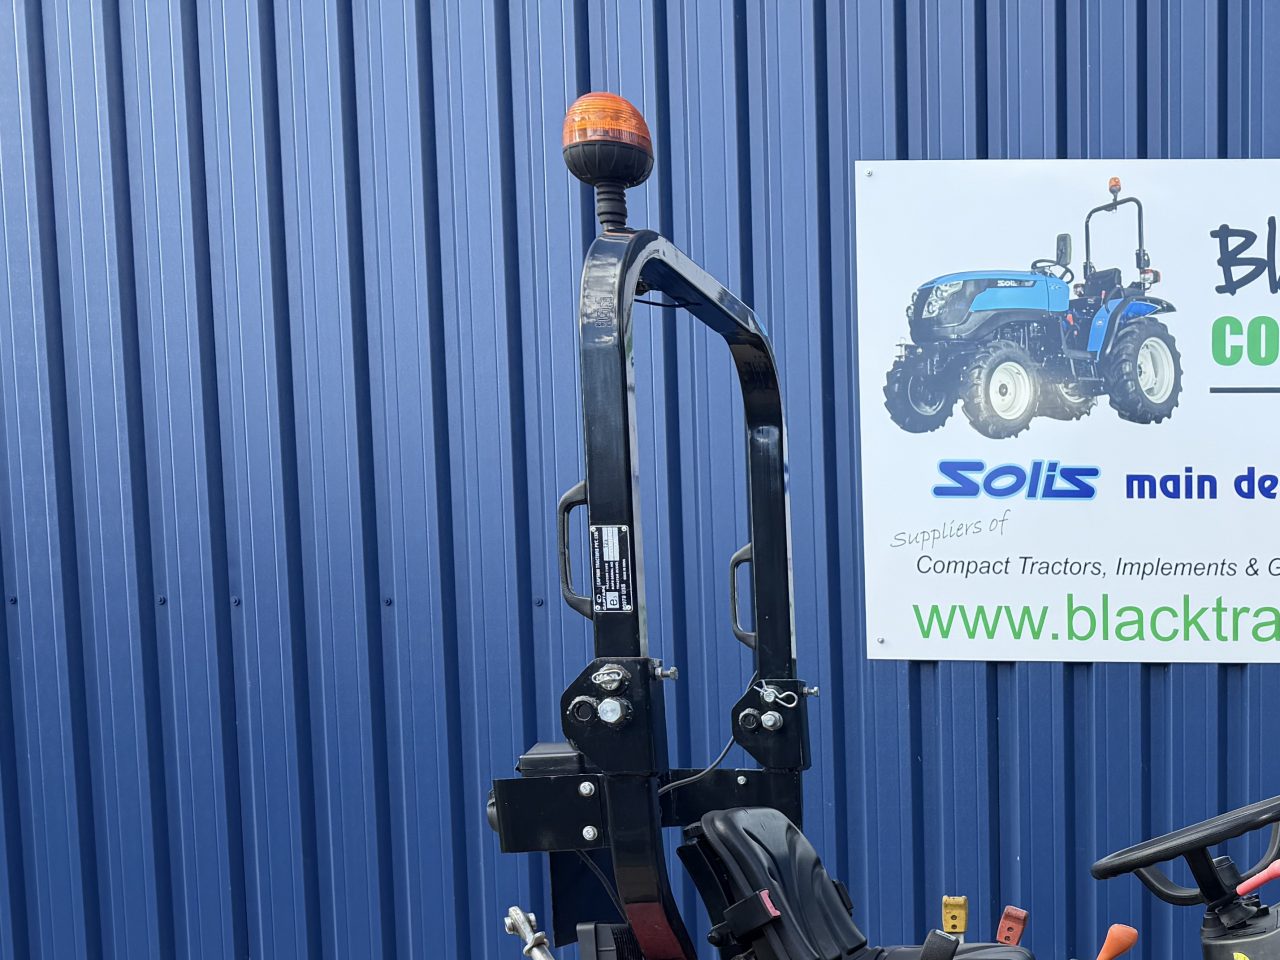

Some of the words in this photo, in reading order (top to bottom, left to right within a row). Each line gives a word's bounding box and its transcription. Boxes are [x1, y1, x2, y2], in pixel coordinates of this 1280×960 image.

[1126, 468, 1217, 500] main
[890, 519, 982, 550] Suppliers
[989, 509, 1011, 536] of
[916, 555, 1011, 579] Compact
[1019, 556, 1106, 578] Tractors,
[1116, 557, 1238, 581] Implements
[1245, 557, 1259, 577] &
